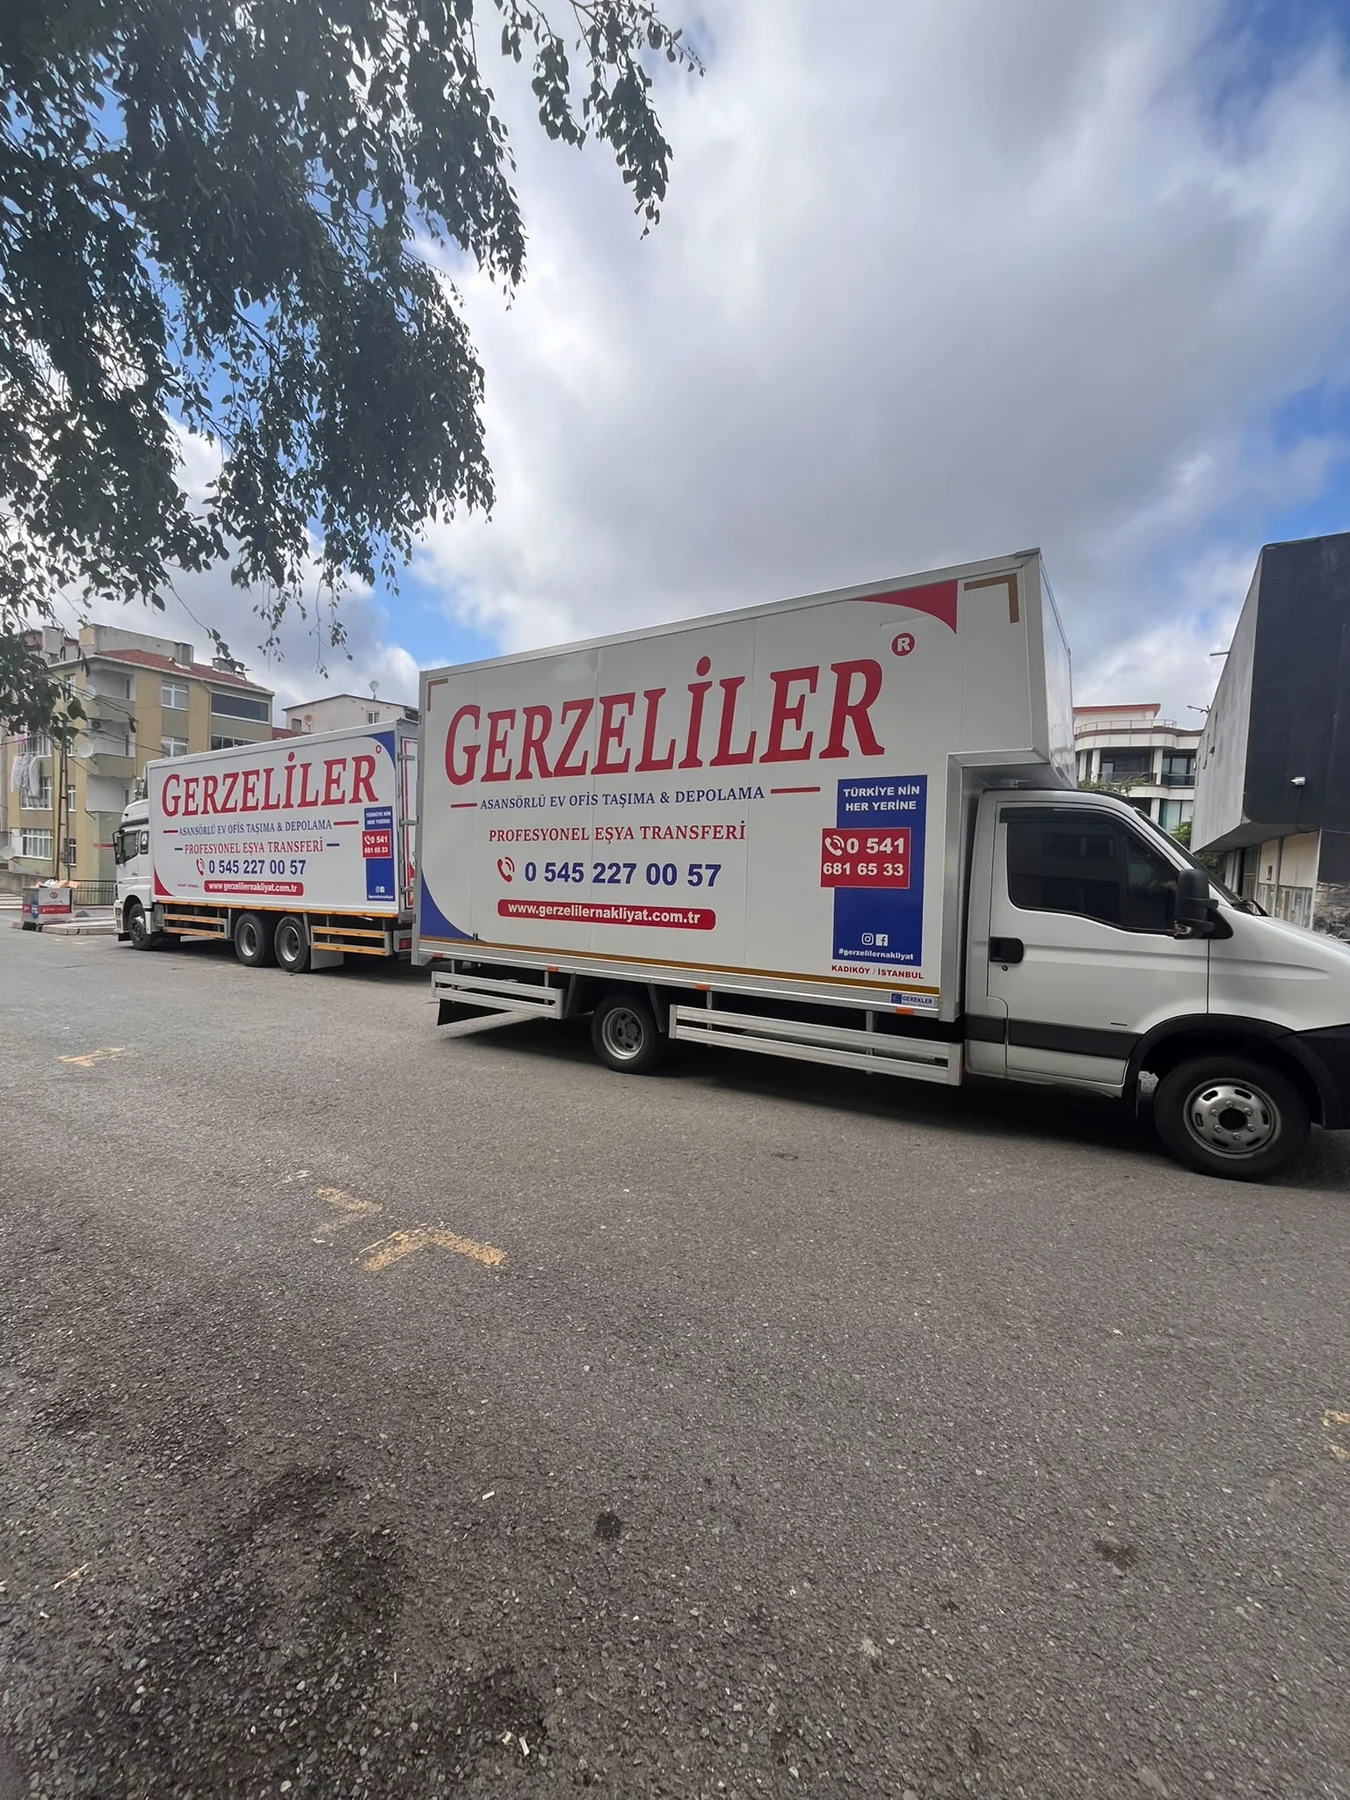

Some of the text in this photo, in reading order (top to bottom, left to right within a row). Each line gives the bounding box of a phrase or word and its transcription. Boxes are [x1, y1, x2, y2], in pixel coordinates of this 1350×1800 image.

[445, 656, 885, 786] GERZELİLER
[162, 752, 378, 816] GERZELİLER
[843, 784, 920, 797] TÜRKİYE NİN
[480, 786, 765, 810] ASANSÖRLÜ EV OFİS TAŞIMA & DEPOLAMA
[845, 799, 916, 811] HER YERİNE
[217, 825, 226, 834] EV
[227, 822, 244, 834] OFİS
[246, 822, 275, 835] TAŞIMA
[277, 822, 283, 831] &
[285, 819, 332, 832] DEPOLAMA
[488, 820, 746, 845] PROFESYONEL EŞYA TRANSFERİ
[184, 836, 323, 856] PROFESYONEL EŞYA TRANSFERİ
[846, 837, 904, 854] 0 541
[209, 860, 306, 875] 0 545 227 00 57
[524, 861, 722, 887] 0 545 227 00 57
[823, 862, 904, 876] 681 65 33
[507, 903, 701, 924] www.gerzelilernakliyat.com.tr
[877, 967, 924, 980] İSTANBUL
